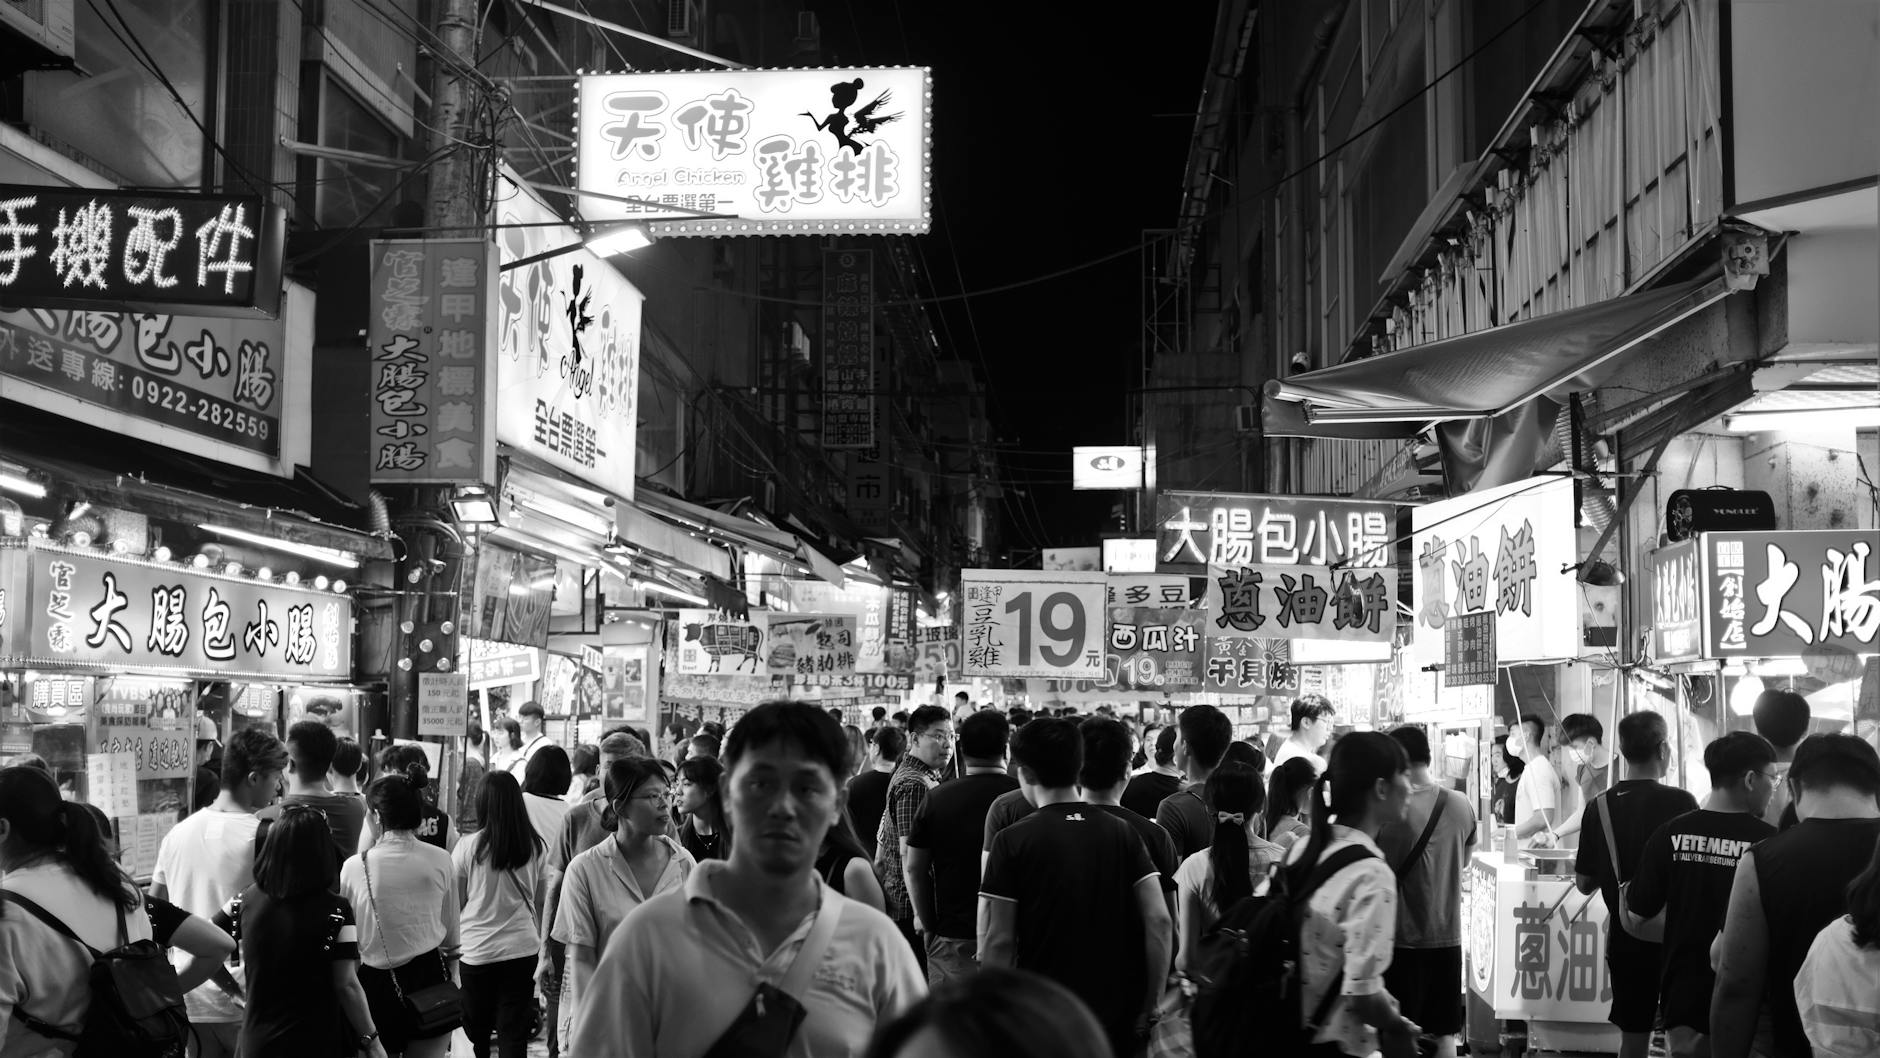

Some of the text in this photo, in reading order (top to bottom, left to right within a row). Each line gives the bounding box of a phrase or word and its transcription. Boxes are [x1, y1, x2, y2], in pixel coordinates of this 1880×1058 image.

[602, 88, 754, 162] 天使
[617, 168, 747, 187] Angel Chicken
[625, 193, 734, 214] 全台票選第一
[752, 136, 899, 213] 雞排
[0, 196, 254, 294] 手機配件
[373, 334, 429, 471] 大腸包小腸
[560, 347, 594, 400] Angel
[131, 375, 270, 441] 0922-282559
[534, 397, 607, 469] 全台票選第一
[1163, 506, 1389, 568] 大腸包小腸
[47, 560, 75, 653] 官芝霖
[85, 569, 319, 663] 大腸包小腸
[1216, 567, 1388, 633] 蔥油餅
[1751, 541, 1880, 645] 大腸
[967, 602, 1004, 669] 豆乳雞
[1005, 591, 1100, 668] 19 元
[1111, 623, 1199, 652] 西瓜汁
[1214, 636, 1253, 656] 黃金
[33, 679, 85, 708] 購買區
[1207, 657, 1299, 690] 干貝燒
[1510, 900, 1612, 1003] 蔥油
